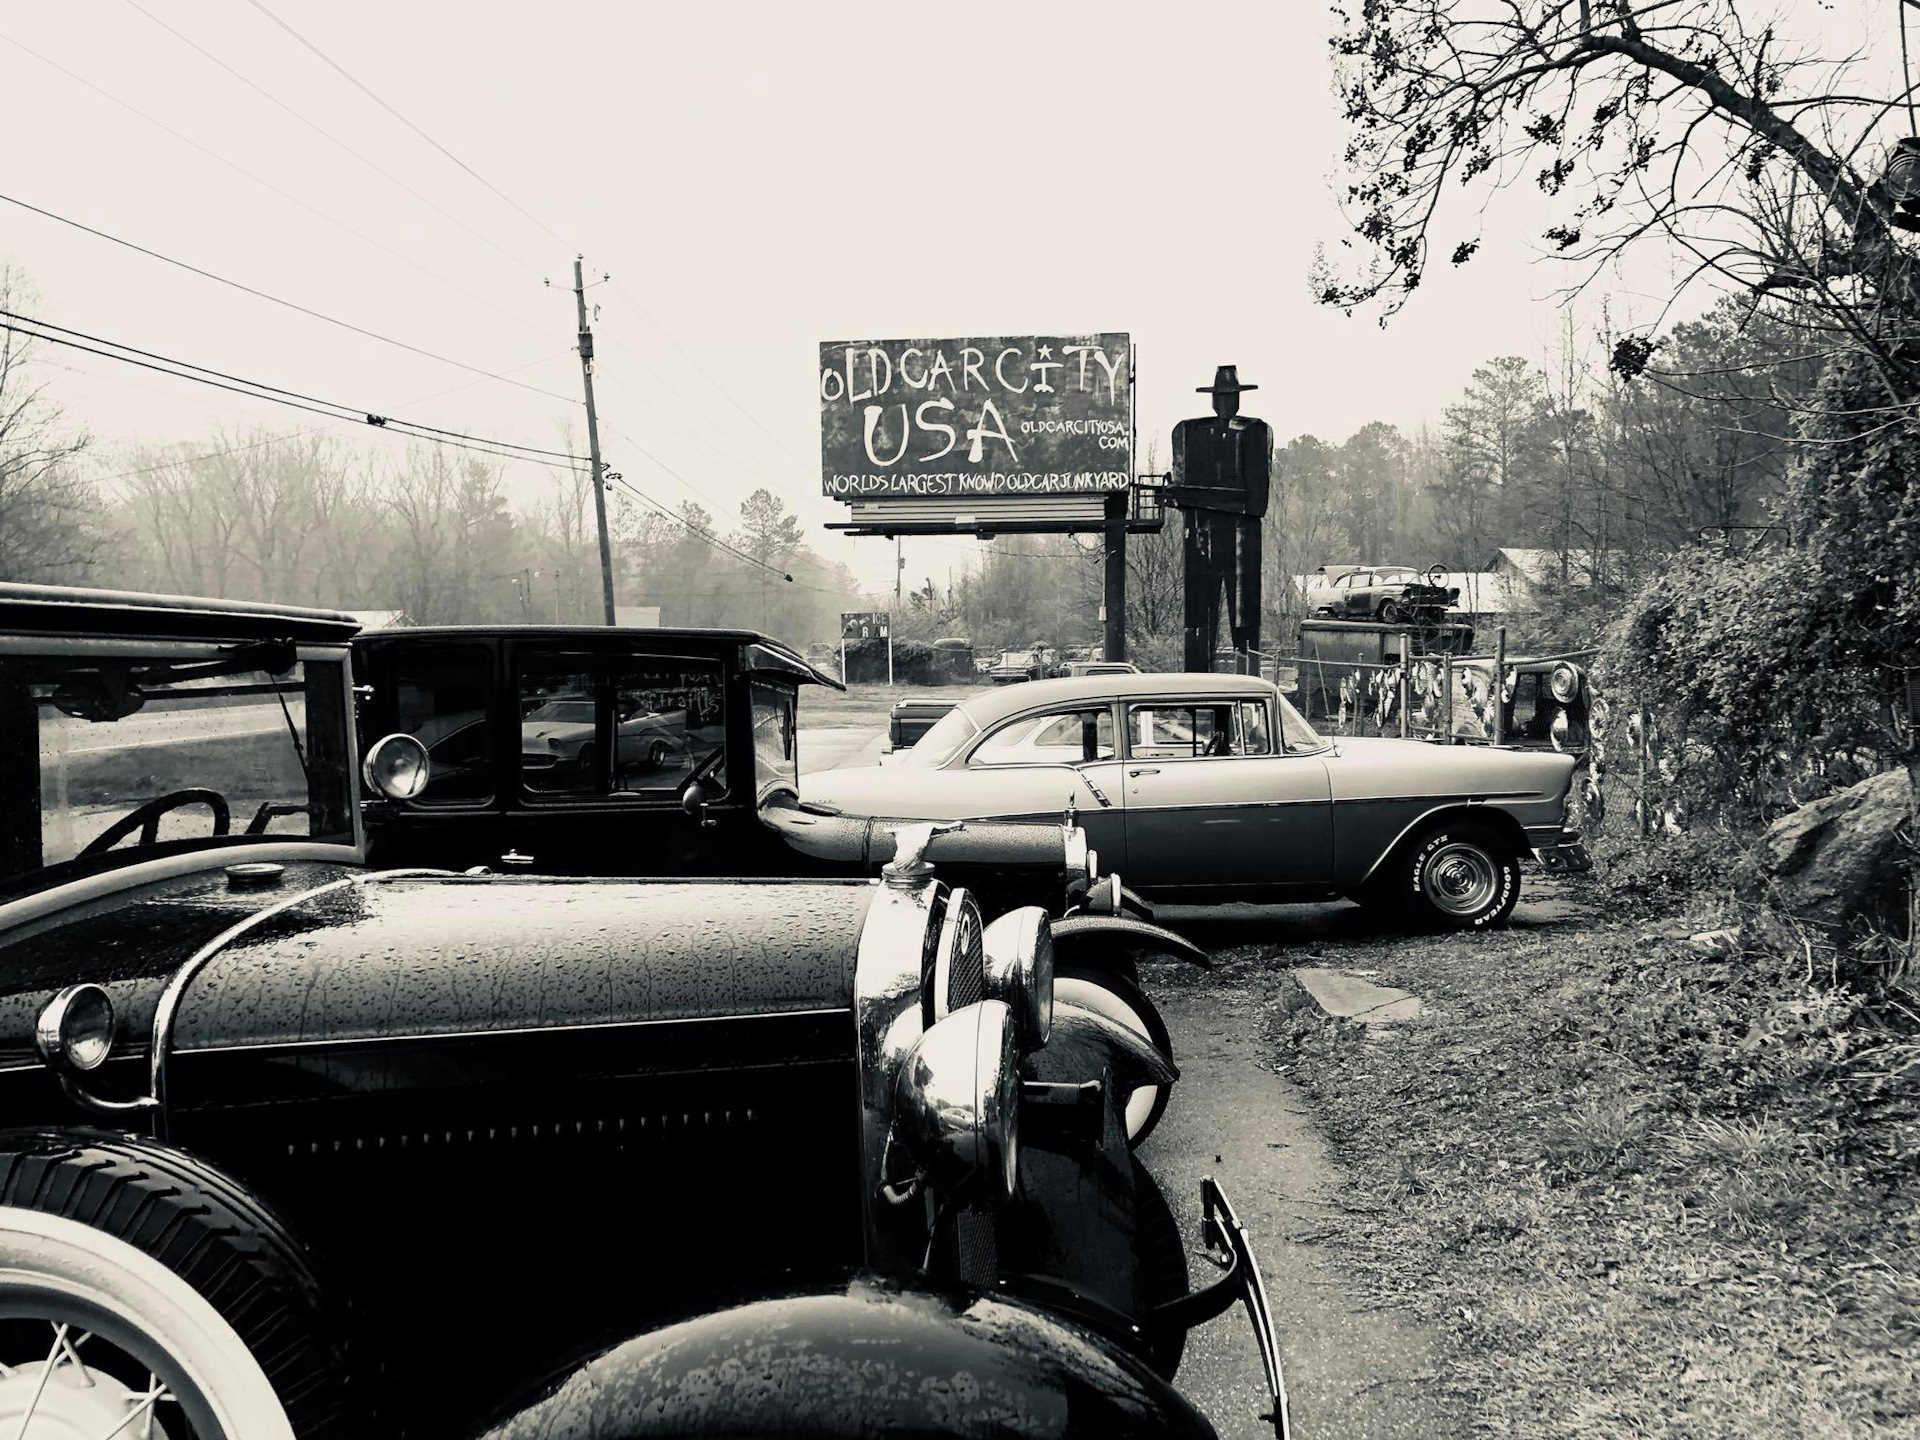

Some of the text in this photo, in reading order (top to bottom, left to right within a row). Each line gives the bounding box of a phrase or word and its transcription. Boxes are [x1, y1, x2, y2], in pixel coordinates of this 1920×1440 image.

[863, 397, 1019, 467] USA
[1098, 436, 1129, 451] COM
[824, 474, 889, 494] WORLDS
[890, 473, 957, 494] LARGEST
[872, 613, 887, 624] ICE
[1413, 853, 1426, 891] EAGLE
[1474, 866, 1511, 925] GOODYEAR
